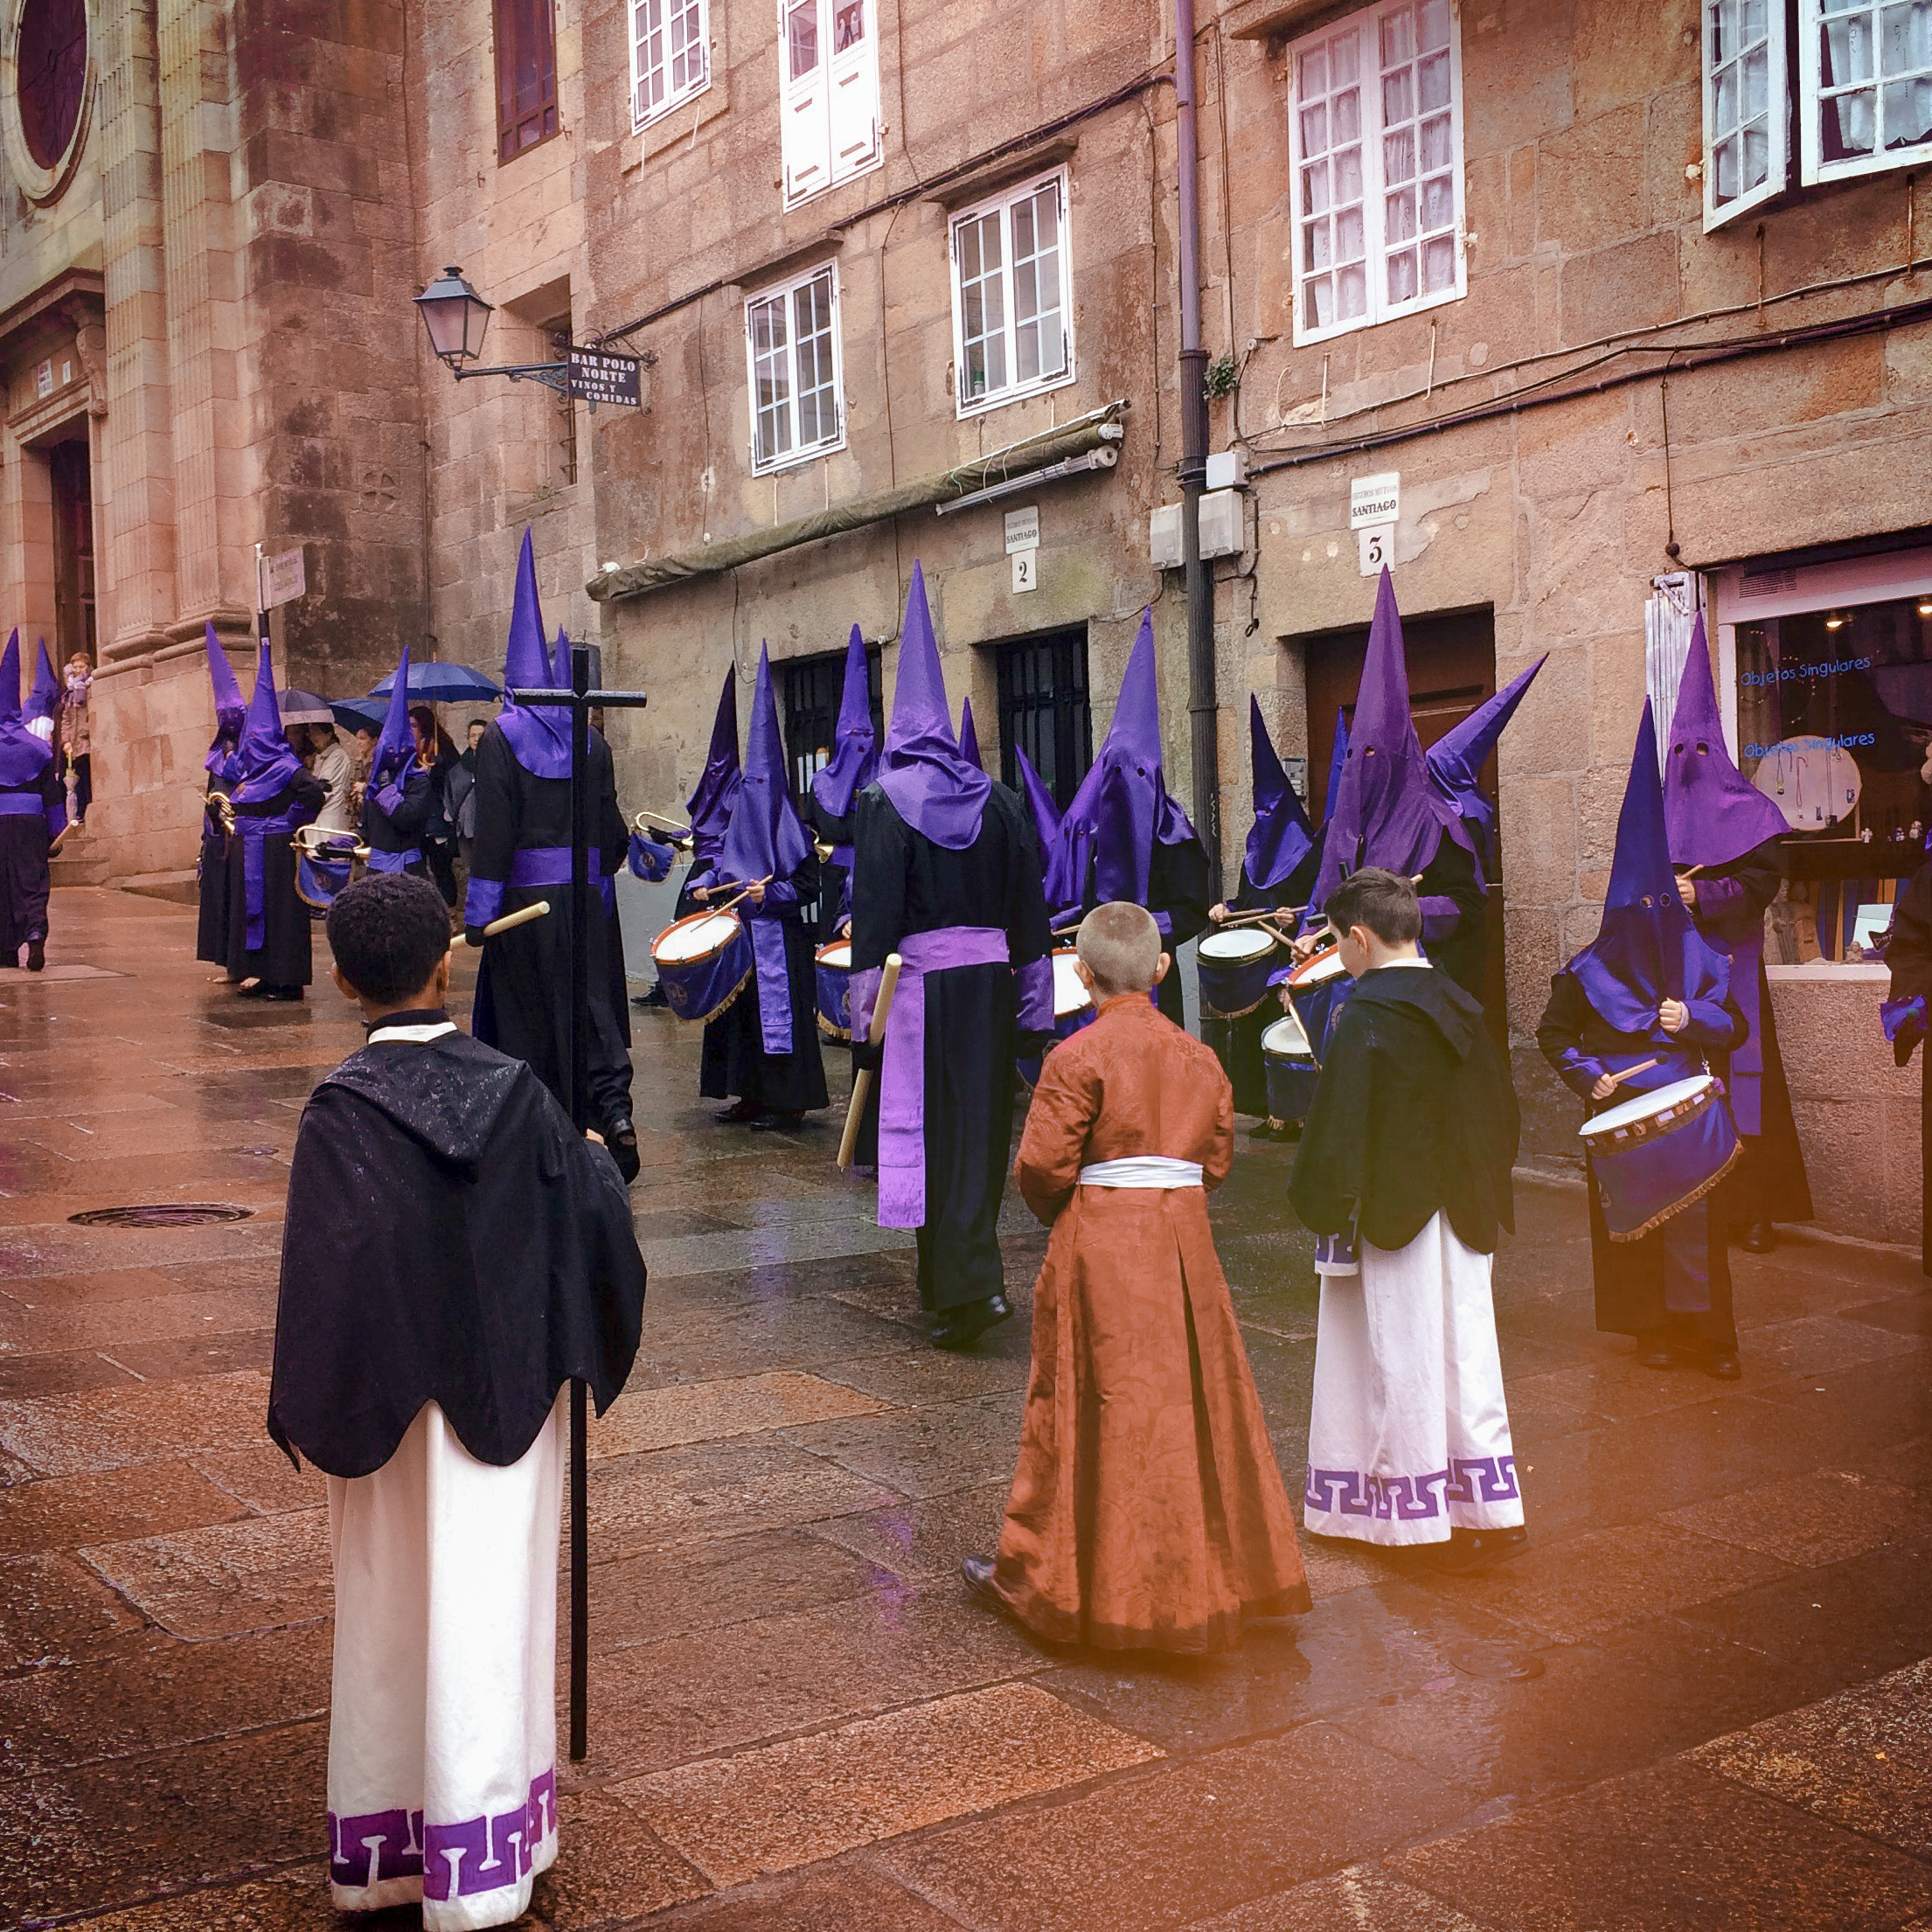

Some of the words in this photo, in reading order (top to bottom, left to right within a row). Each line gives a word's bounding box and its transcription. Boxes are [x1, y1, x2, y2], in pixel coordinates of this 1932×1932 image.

[571, 352, 599, 367] BAR
[602, 357, 636, 372] POLO
[581, 367, 627, 384] NORTE
[571, 379, 605, 392] VINOS
[609, 385, 616, 393] Y
[586, 391, 637, 406] COMIDAS
[1352, 499, 1397, 518] SANTIAGO
[1006, 529, 1038, 545] SANTIAGO
[1369, 535, 1383, 564] 3
[1018, 560, 1028, 583] 2
[1740, 667, 1796, 687] Objetos
[1799, 656, 1872, 679] Singulares
[1744, 740, 1799, 760] Objetos
[1804, 732, 1875, 753] Singulares
